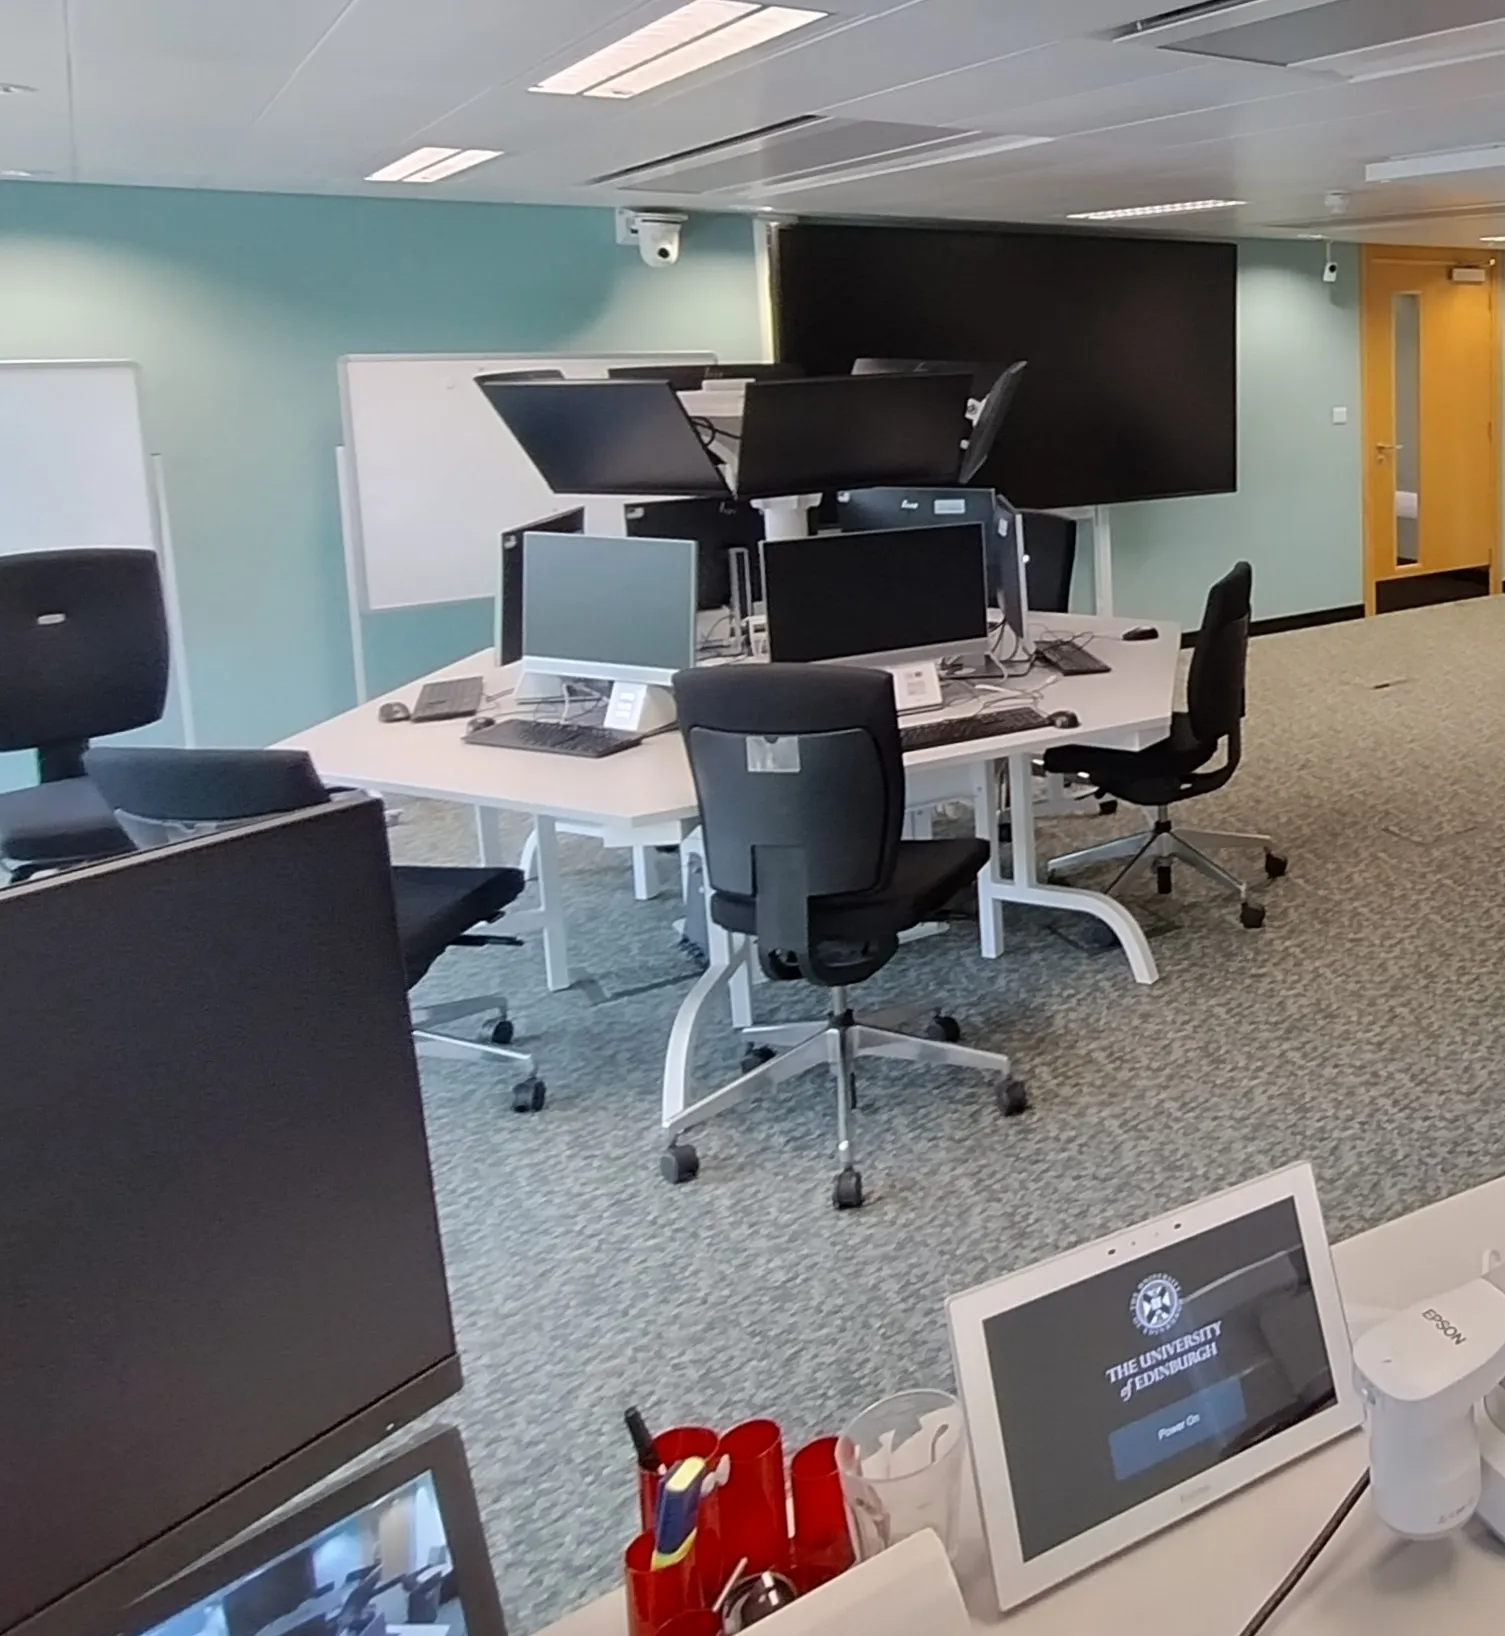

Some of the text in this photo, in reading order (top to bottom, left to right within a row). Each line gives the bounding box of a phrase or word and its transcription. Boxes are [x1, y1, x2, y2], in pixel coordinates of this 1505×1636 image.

[1421, 1308, 1467, 1345] EPSON
[1105, 1320, 1222, 1384] THE UNIVERSITY
[1120, 1342, 1218, 1402] of EDINBURGH
[1158, 1414, 1200, 1441] Power On
